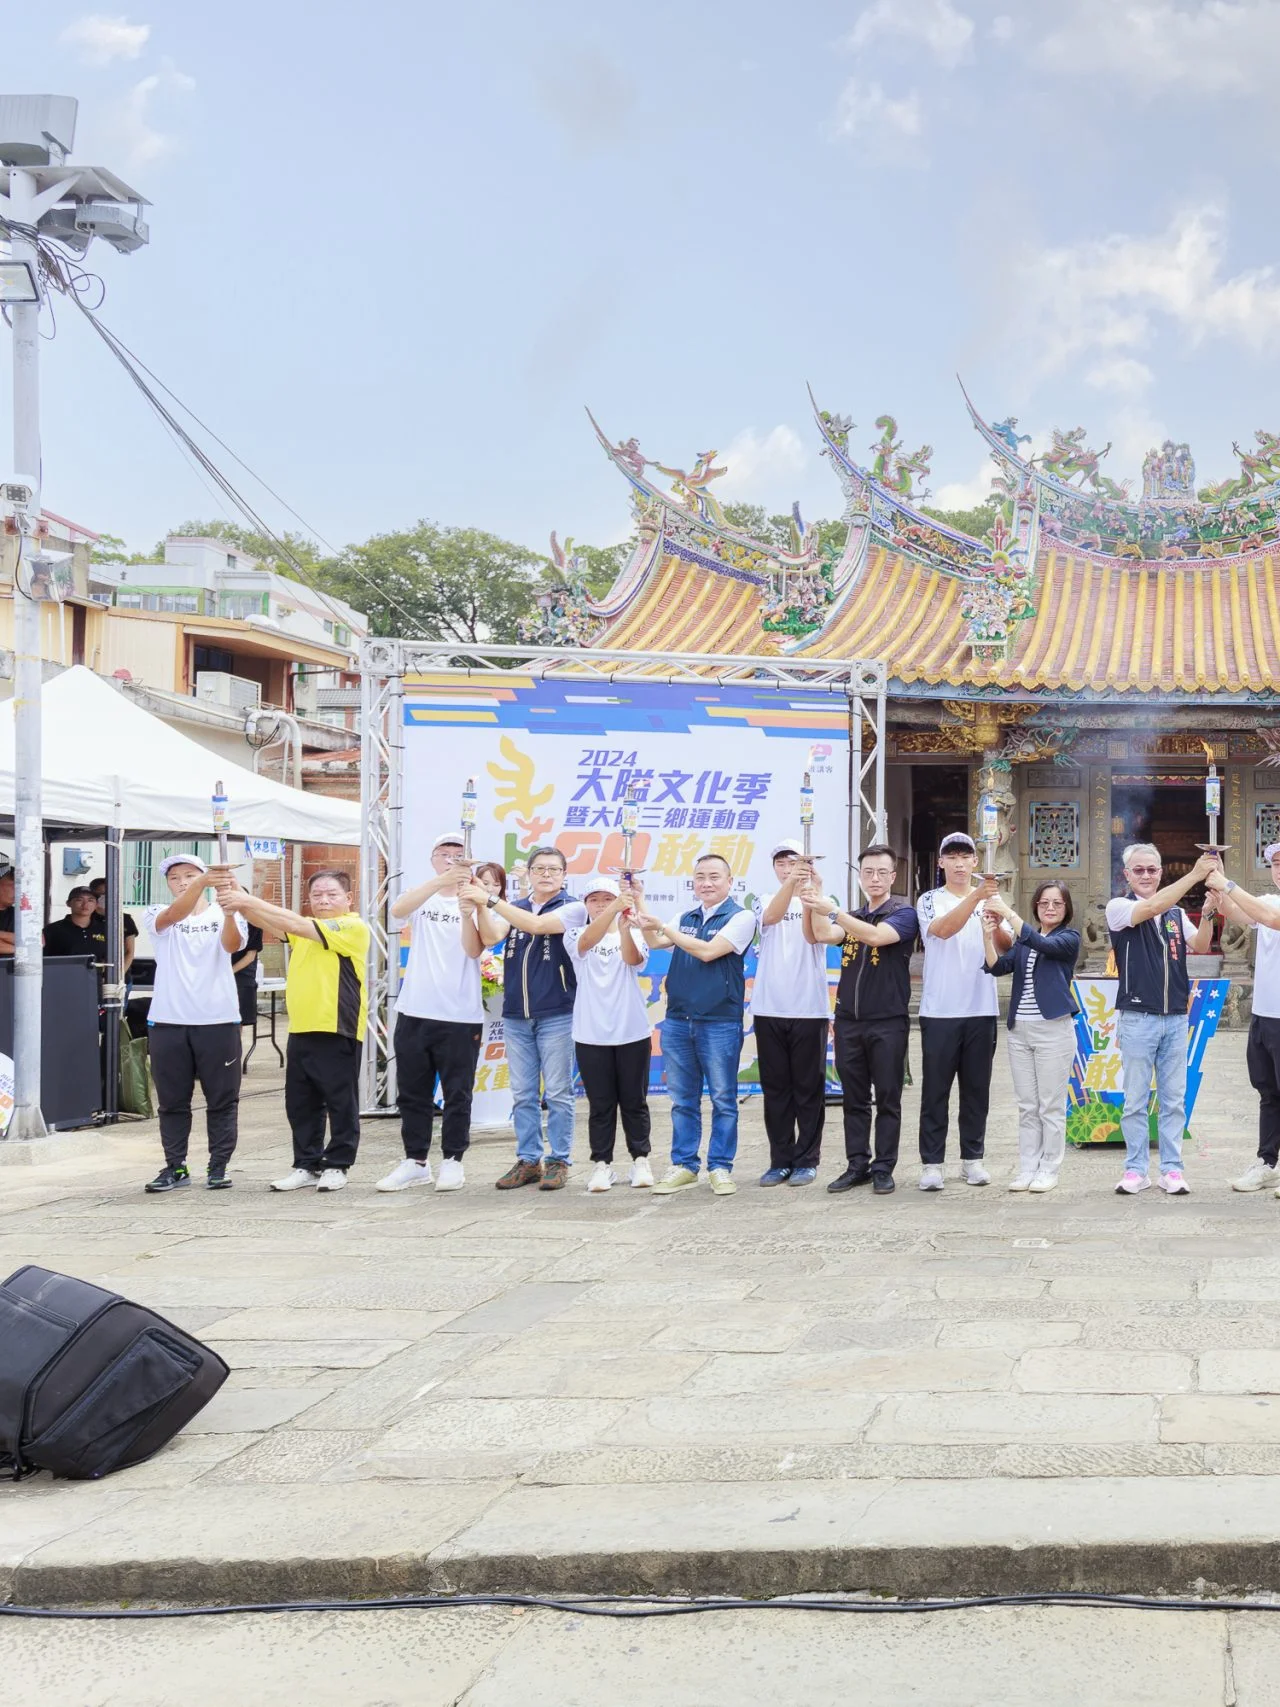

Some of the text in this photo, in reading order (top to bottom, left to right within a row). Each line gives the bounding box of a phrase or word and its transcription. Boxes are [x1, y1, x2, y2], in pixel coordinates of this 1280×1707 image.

[578, 750, 638, 767] 2024
[570, 768, 773, 805] 大隘文化季
